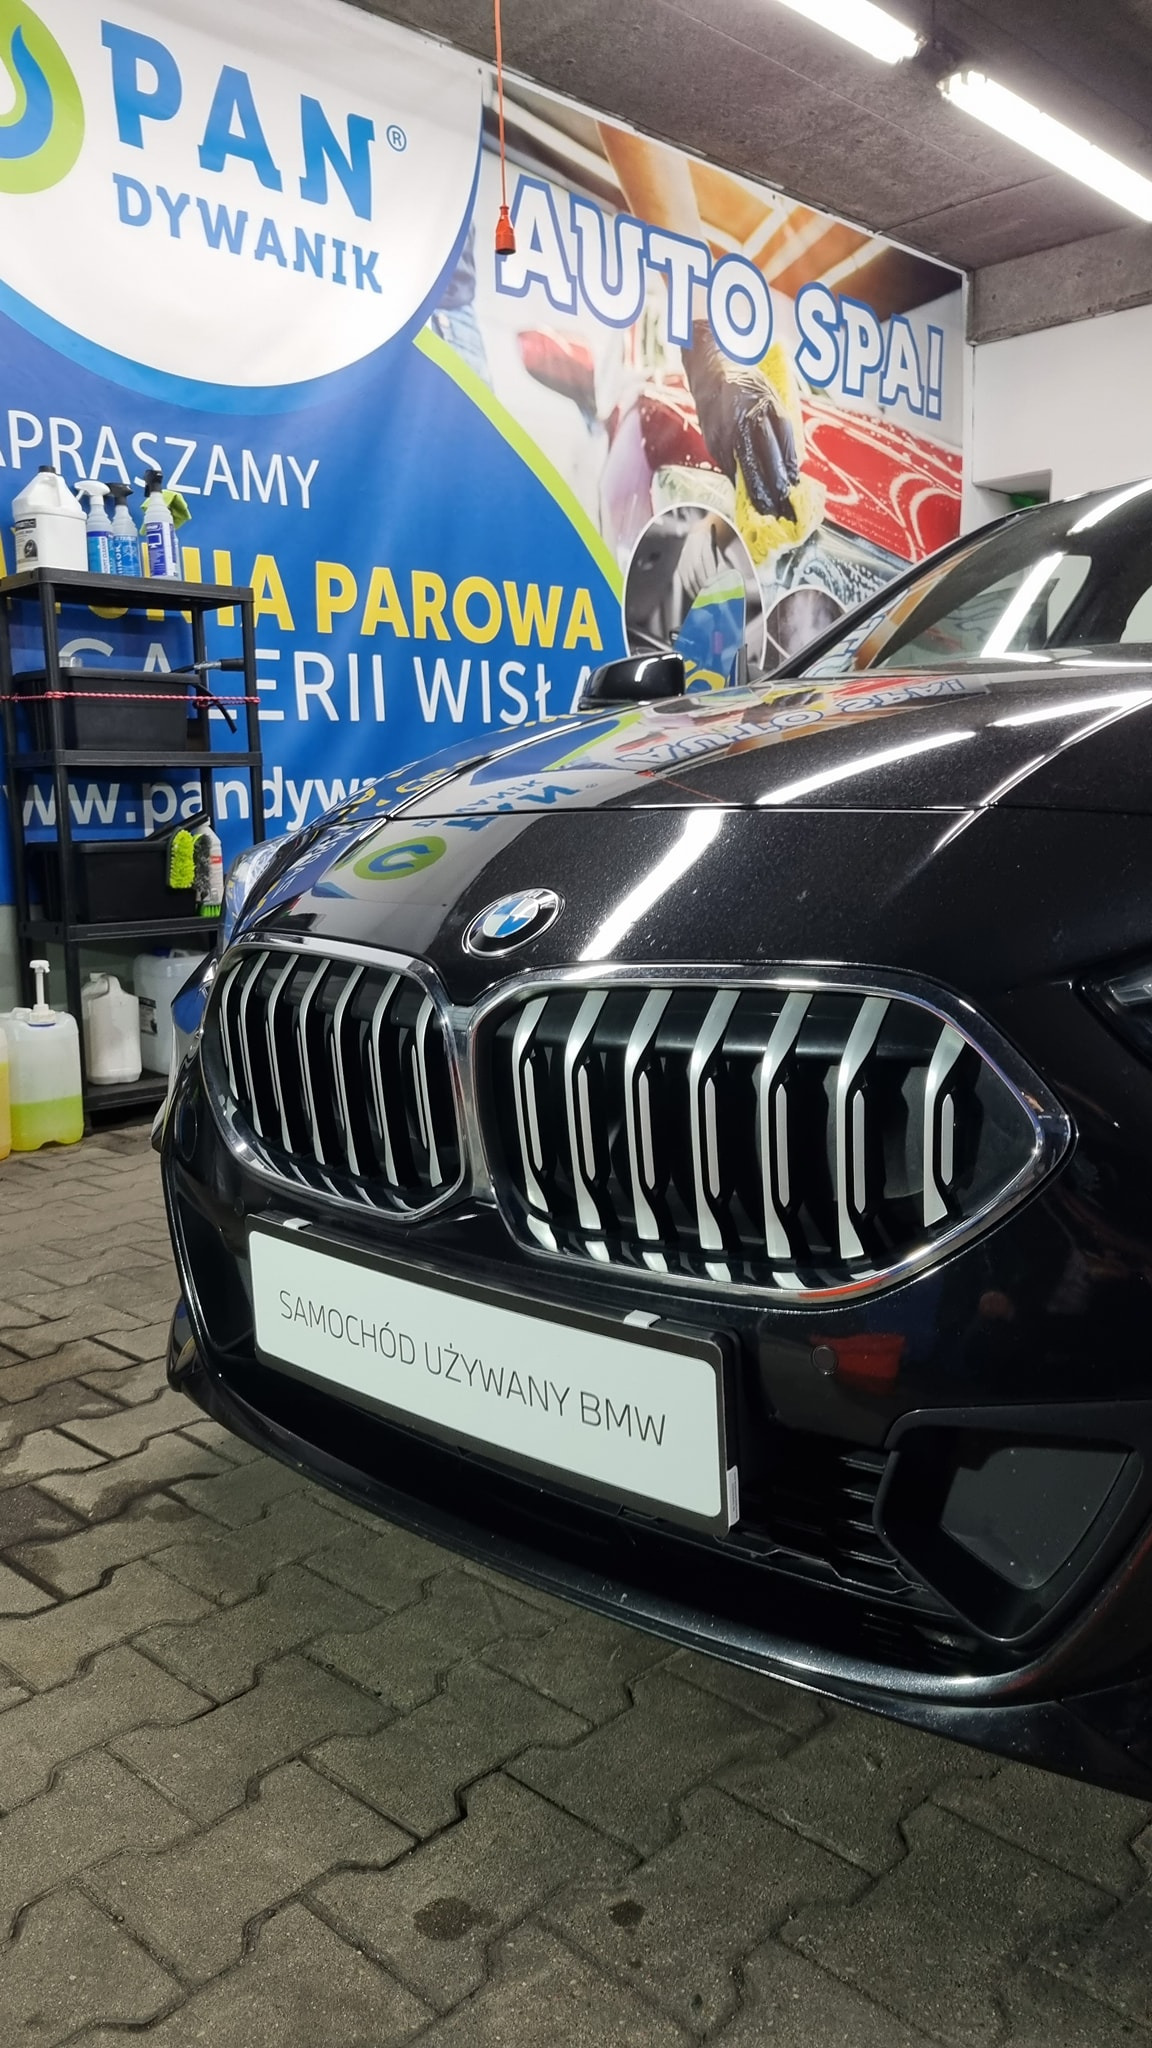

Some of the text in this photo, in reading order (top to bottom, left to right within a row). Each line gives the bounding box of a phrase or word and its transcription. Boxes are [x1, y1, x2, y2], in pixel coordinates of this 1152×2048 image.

[100, 19, 375, 222] PAN
[112, 171, 383, 295] DYWANIK
[495, 173, 944, 421] AUTO SPA!
[0, 409, 319, 509] PRASZAMY
[315, 560, 604, 652] PAROWA
[278, 1289, 667, 1447] SAMOCHÓD UŻYWANY BMW
